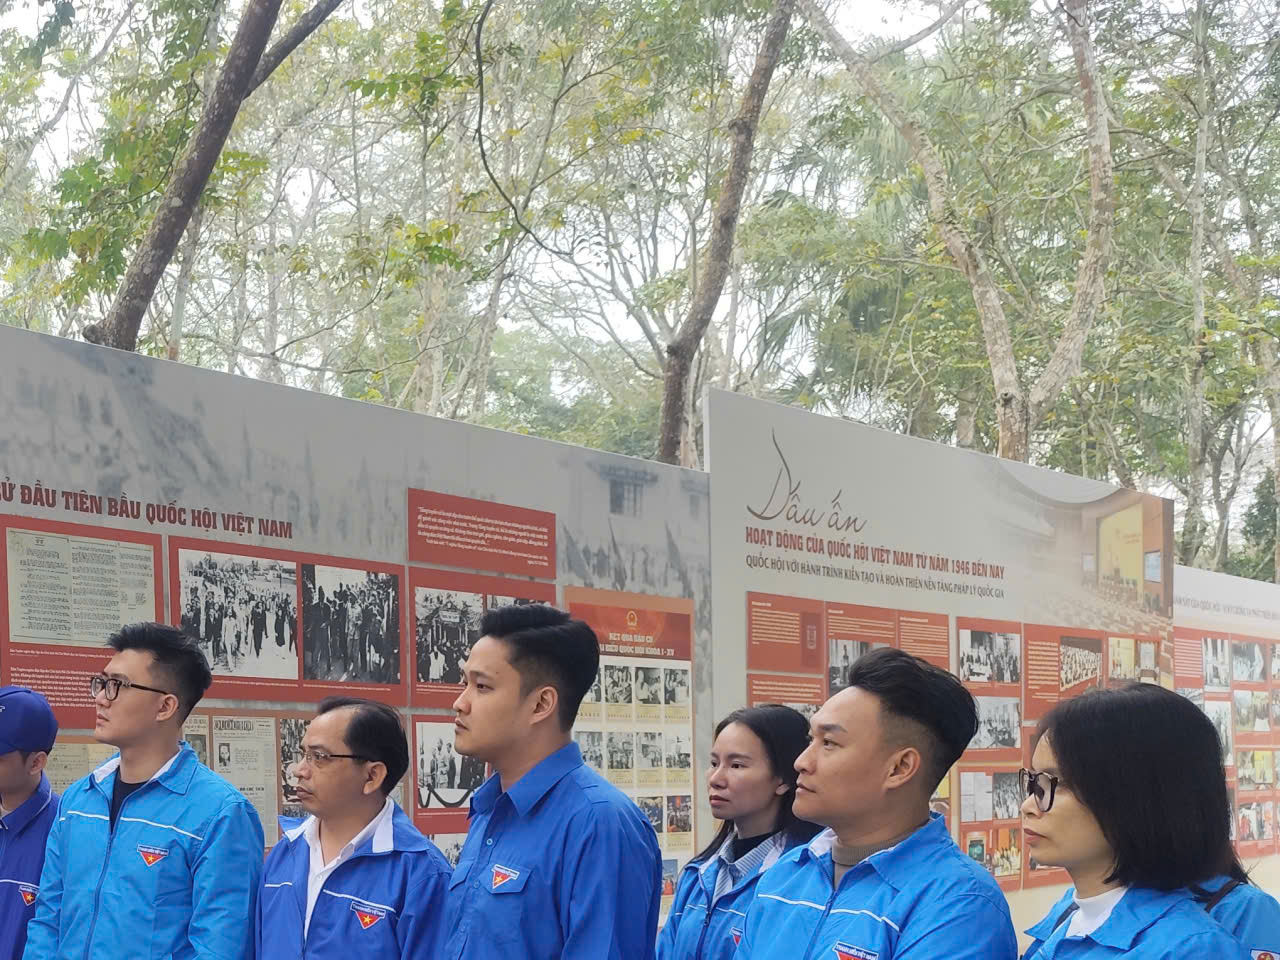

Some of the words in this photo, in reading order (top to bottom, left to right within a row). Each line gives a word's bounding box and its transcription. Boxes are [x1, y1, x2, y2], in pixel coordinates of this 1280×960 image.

[20, 479, 56, 508] ĐẦU
[62, 490, 102, 514] TIÊN
[108, 492, 140, 519] BẦU
[146, 500, 186, 525] QUỐC
[192, 508, 218, 532] HỘI
[222, 512, 254, 536] VIỆT
[258, 518, 292, 539] NAM
[828, 489, 867, 533] ấn
[746, 527, 773, 548] HOẠT
[776, 529, 803, 552] ĐỘNG
[806, 532, 825, 555] CỦA
[827, 537, 851, 559] QUỐC
[854, 543, 869, 564] HỘI
[871, 545, 891, 566] VIỆT
[893, 550, 914, 568] NAM
[916, 551, 928, 569] TỪ
[929, 553, 949, 572] NĂM
[951, 560, 970, 575] 1946
[971, 557, 988, 578] ĐẾN
[989, 563, 1005, 580] NAY
[746, 551, 769, 568] QUỐC
[771, 556, 785, 573] HỘI
[786, 559, 800, 573] VỚI
[801, 560, 821, 576] HÀNH
[822, 563, 843, 578] TRÌNH
[844, 564, 860, 581] KIẾN
[861, 571, 875, 584] TẠO
[875, 572, 885, 584] VÀ
[886, 574, 905, 586] HOÀN
